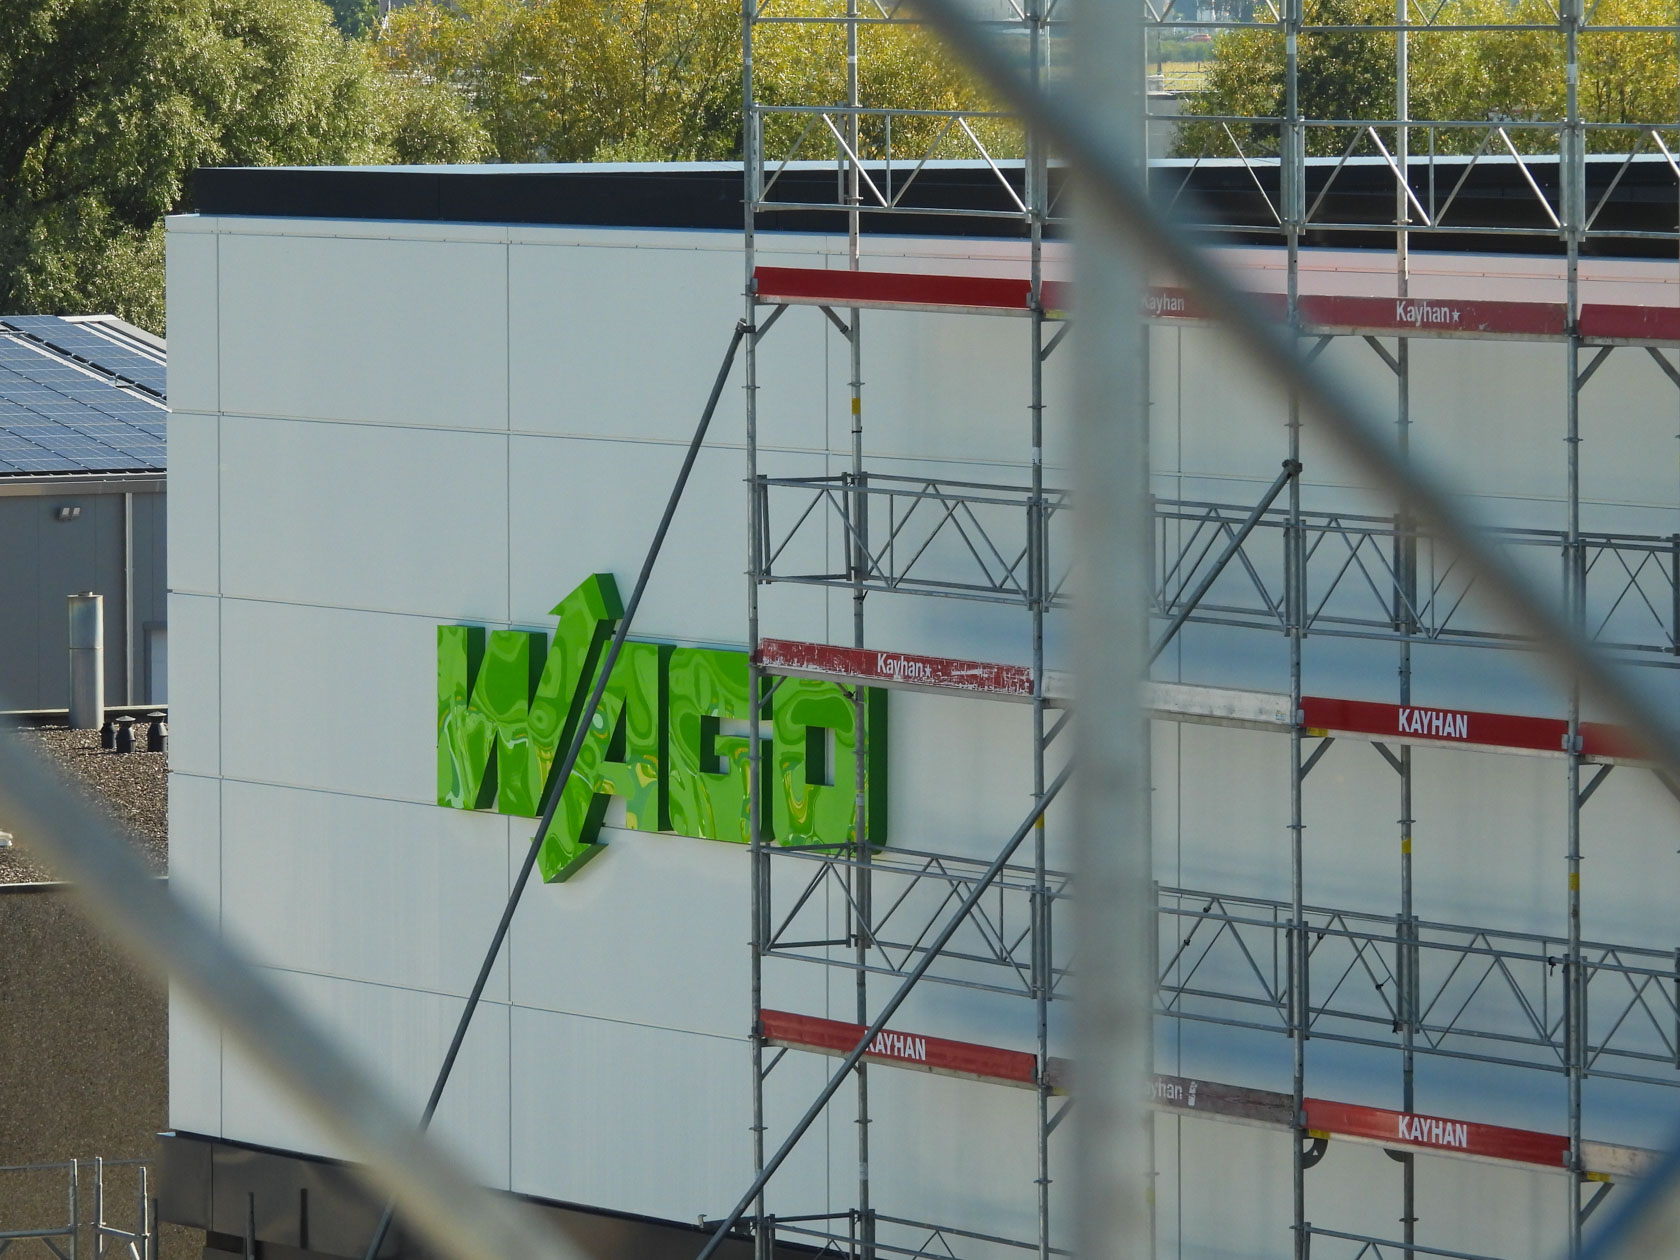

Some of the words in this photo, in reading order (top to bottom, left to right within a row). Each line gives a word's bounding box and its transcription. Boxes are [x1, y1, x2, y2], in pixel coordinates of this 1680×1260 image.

[1396, 301, 1450, 327] Kayhan
[877, 652, 923, 679] Kayhan
[437, 573, 888, 884] WAGO
[1398, 708, 1468, 738] KAYHAN
[1398, 1115, 1467, 1147] KAYHAN
